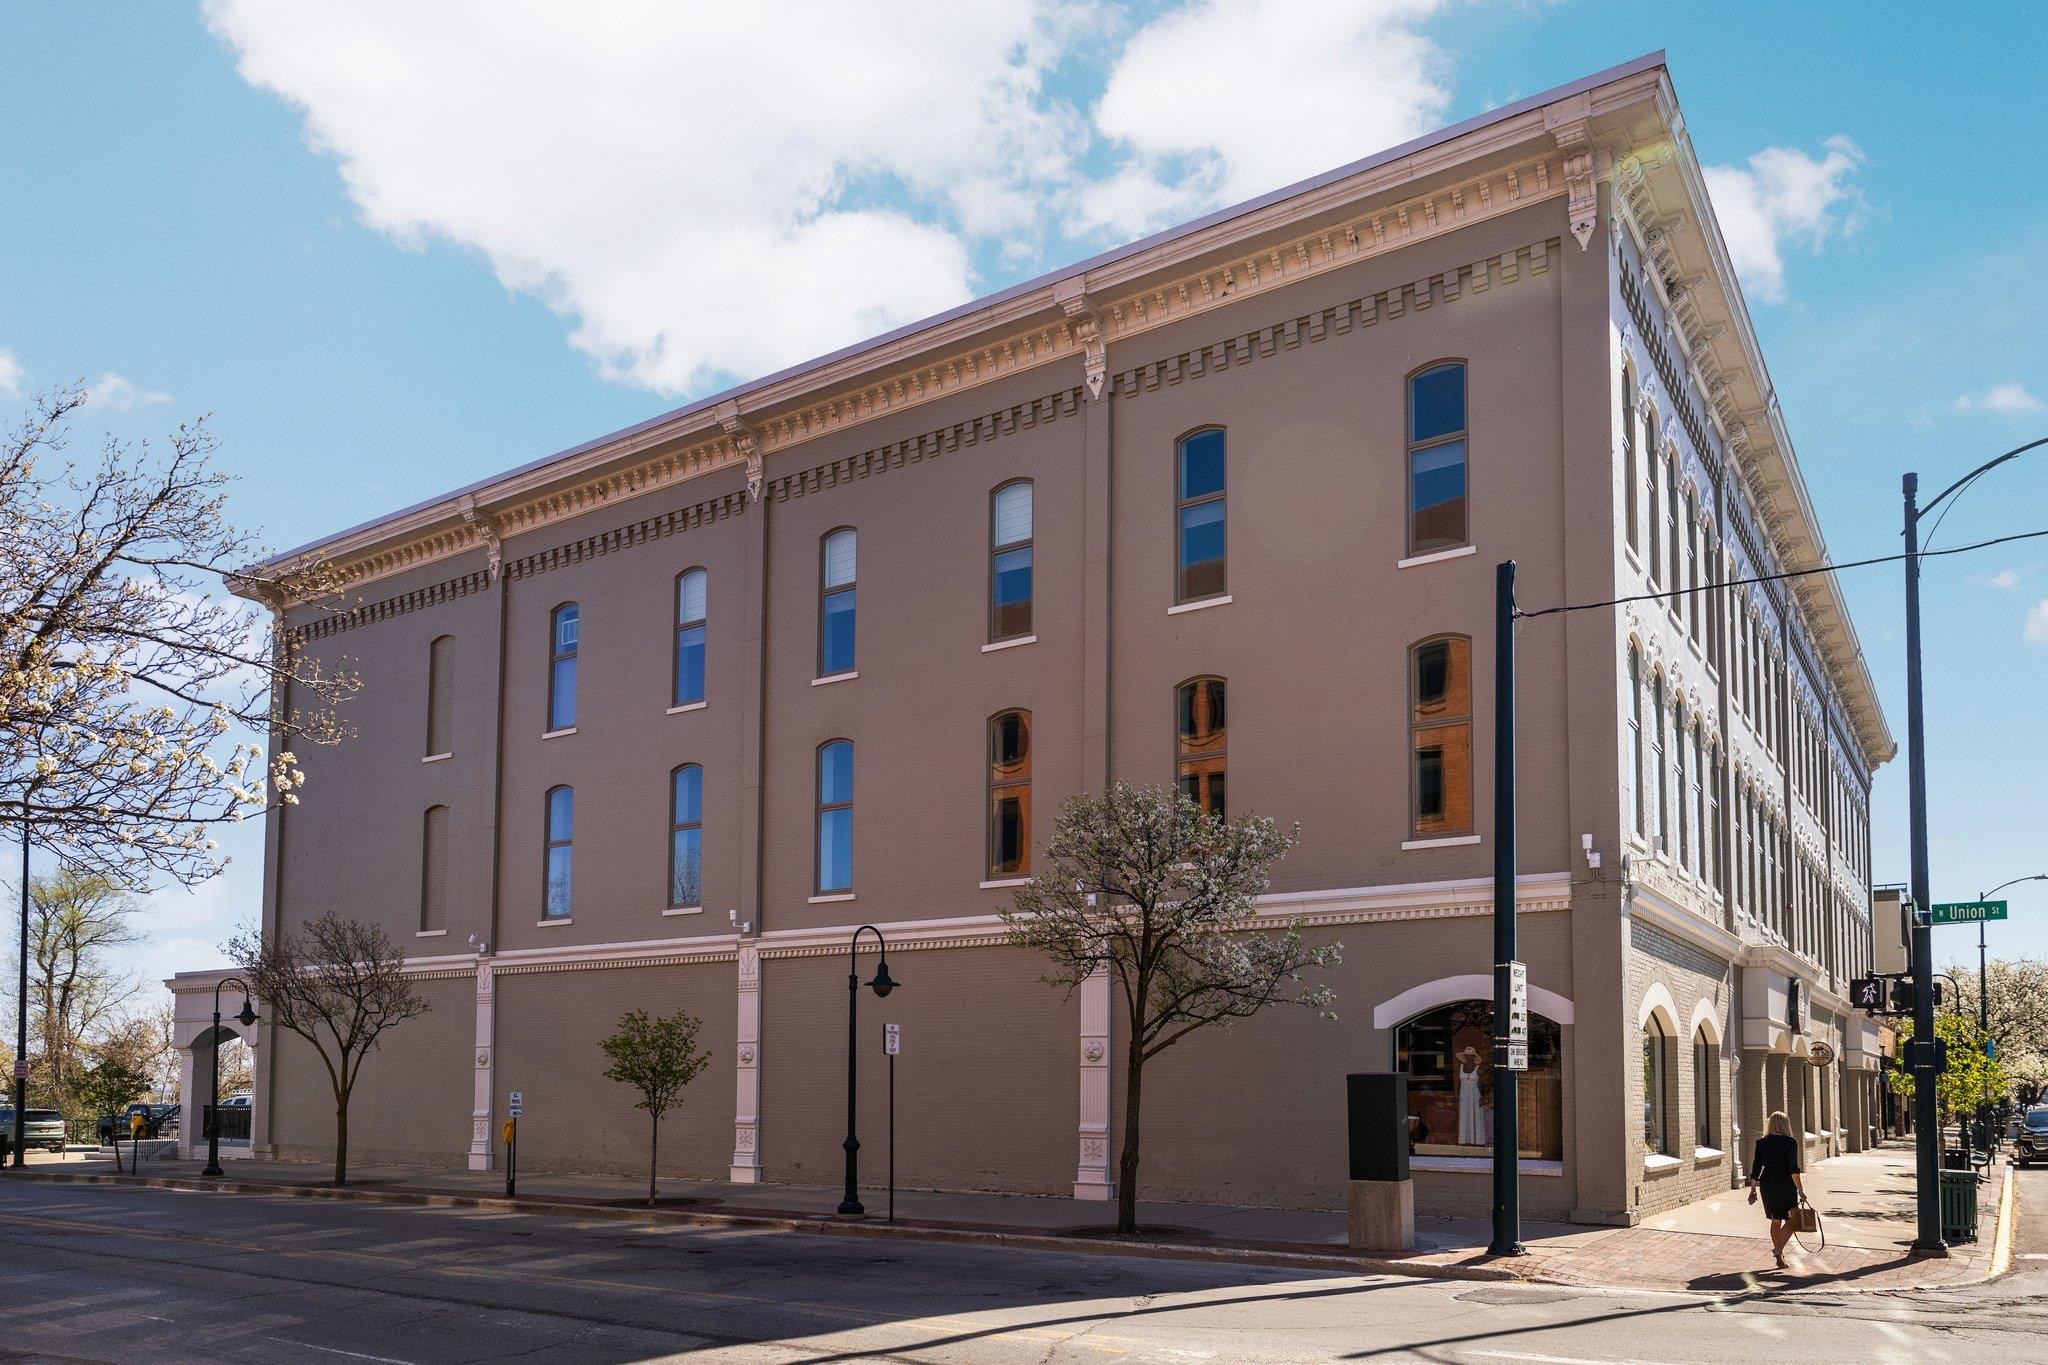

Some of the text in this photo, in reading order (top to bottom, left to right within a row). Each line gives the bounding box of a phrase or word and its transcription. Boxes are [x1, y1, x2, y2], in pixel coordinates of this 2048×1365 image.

[1939, 905, 1999, 920] N Union St
